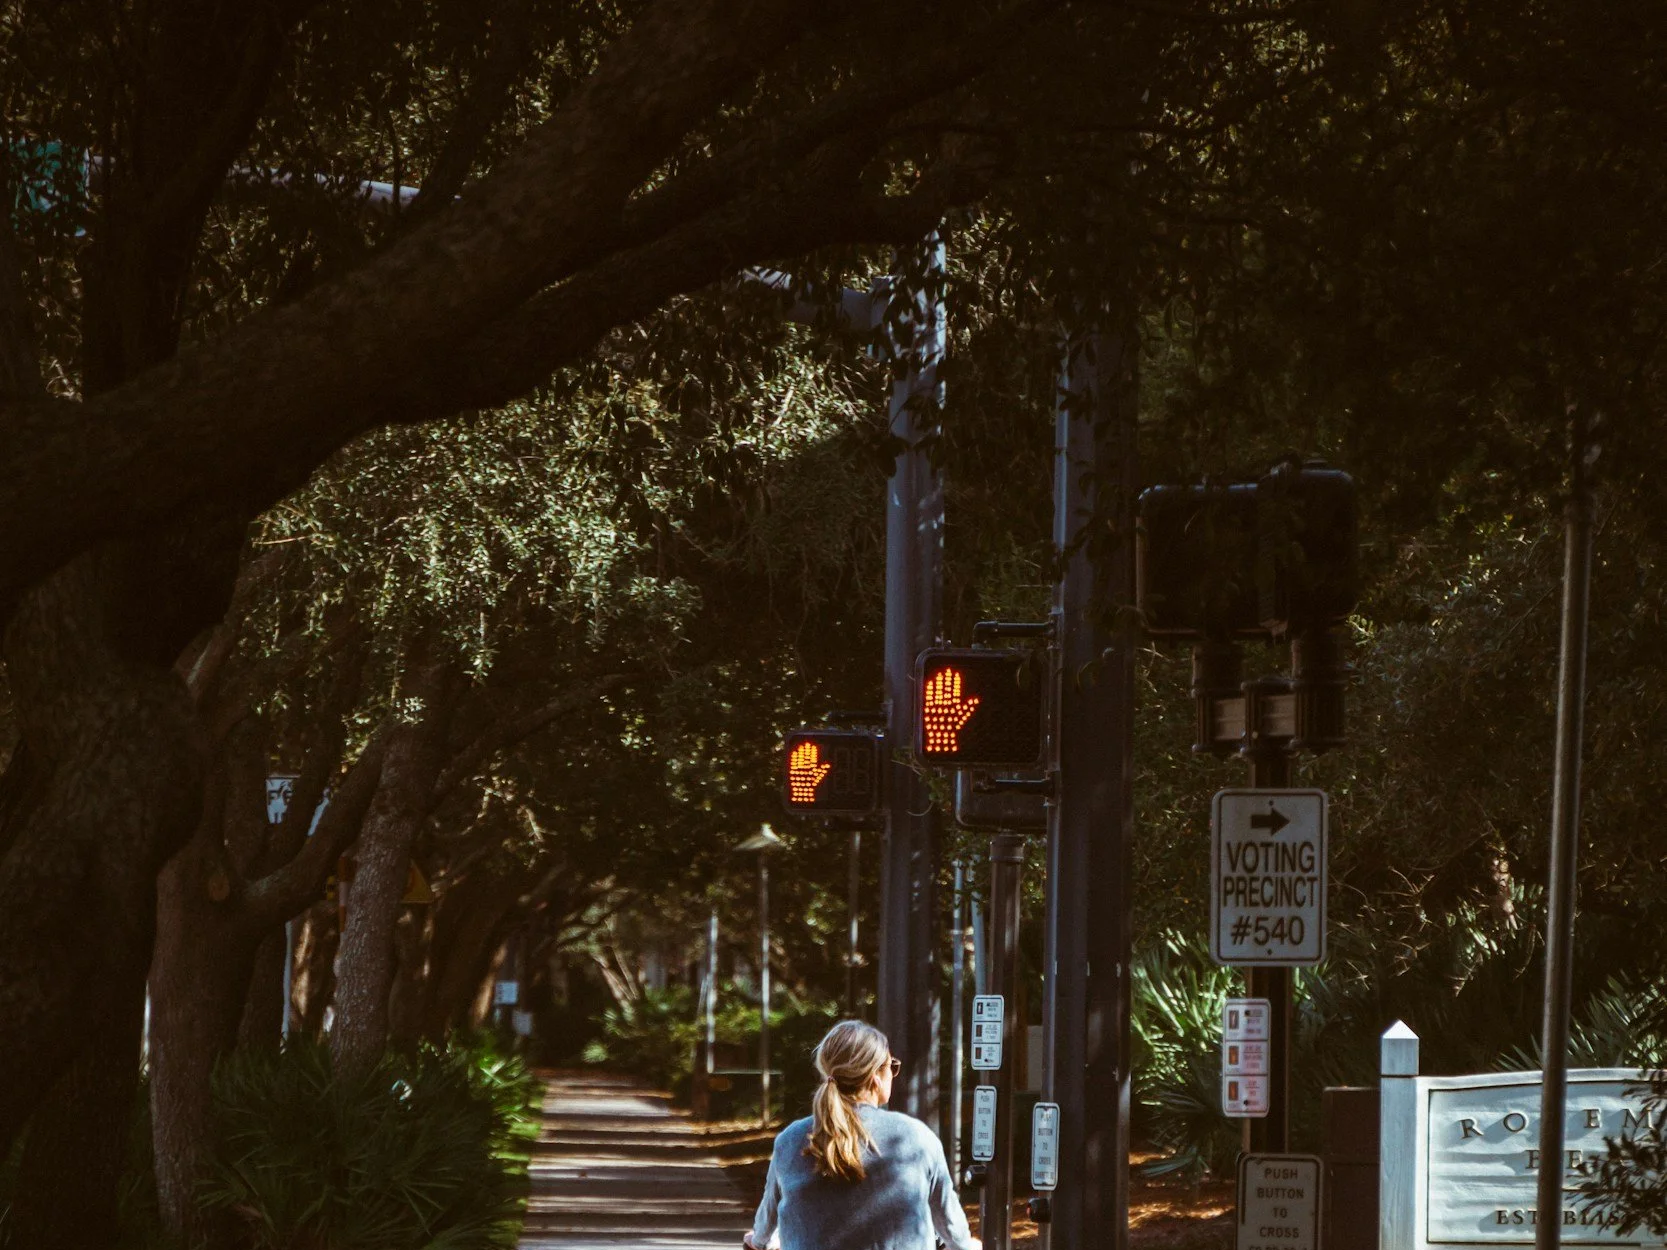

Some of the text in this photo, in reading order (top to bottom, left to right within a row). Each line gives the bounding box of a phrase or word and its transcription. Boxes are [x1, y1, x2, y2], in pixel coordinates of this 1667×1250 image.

[1226, 841, 1315, 874] VOTING
[1223, 876, 1318, 908] PRECINCT
[1230, 915, 1304, 946] #540
[1459, 1108, 1655, 1139] ROEM
[1264, 1167, 1298, 1180] PUSH
[1257, 1187, 1304, 1200] BUTTON
[1272, 1207, 1288, 1219] TO
[1259, 1226, 1300, 1239] CROSS
